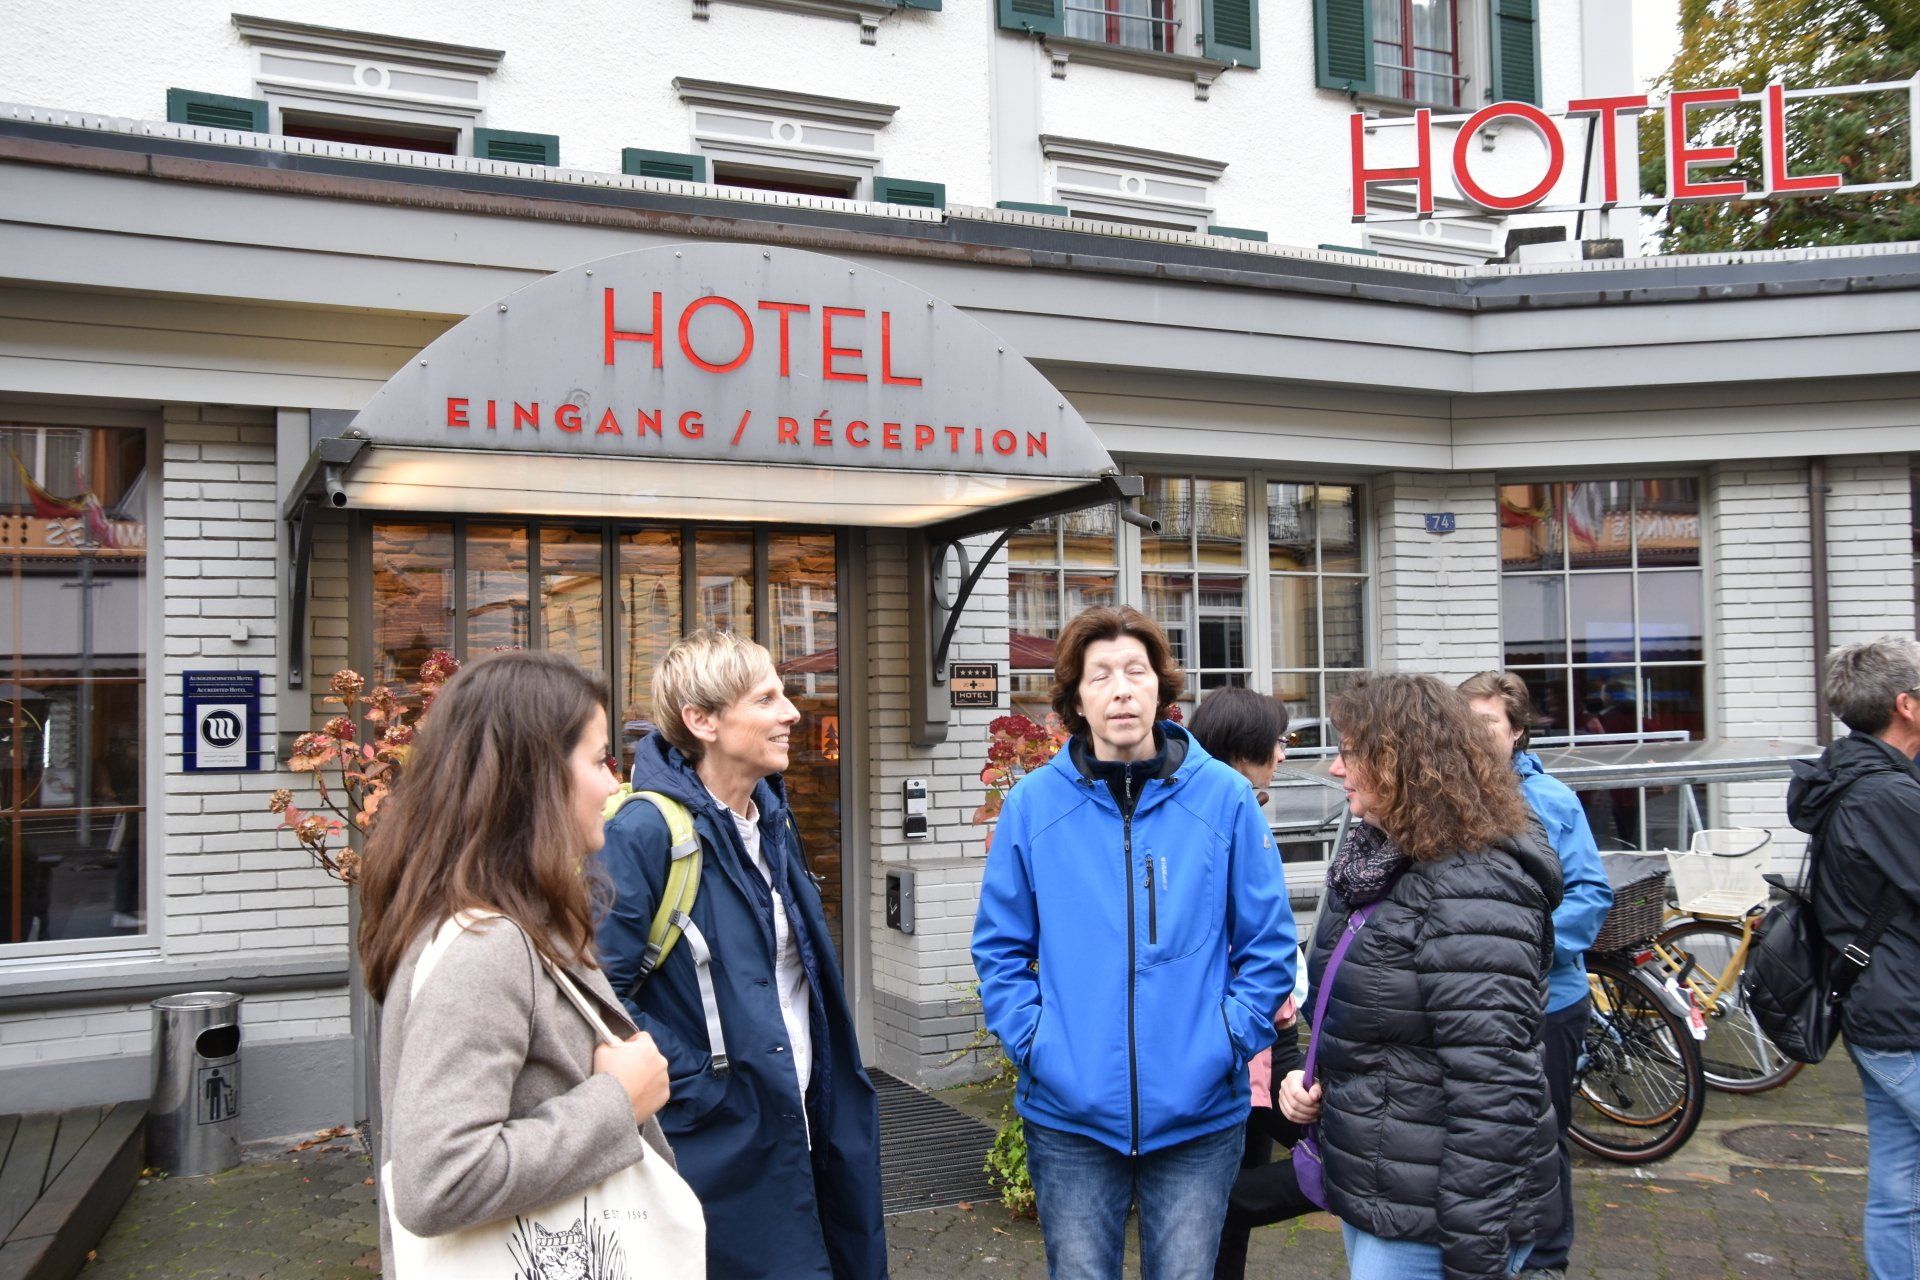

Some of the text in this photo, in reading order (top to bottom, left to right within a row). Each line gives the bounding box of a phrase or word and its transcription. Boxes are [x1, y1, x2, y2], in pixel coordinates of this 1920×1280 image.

[1350, 83, 1842, 223] HOTEL
[604, 287, 923, 387] HOTEL
[446, 396, 1050, 458] EINGANG / RÉCEPTION
[1431, 514, 1449, 529] 74
